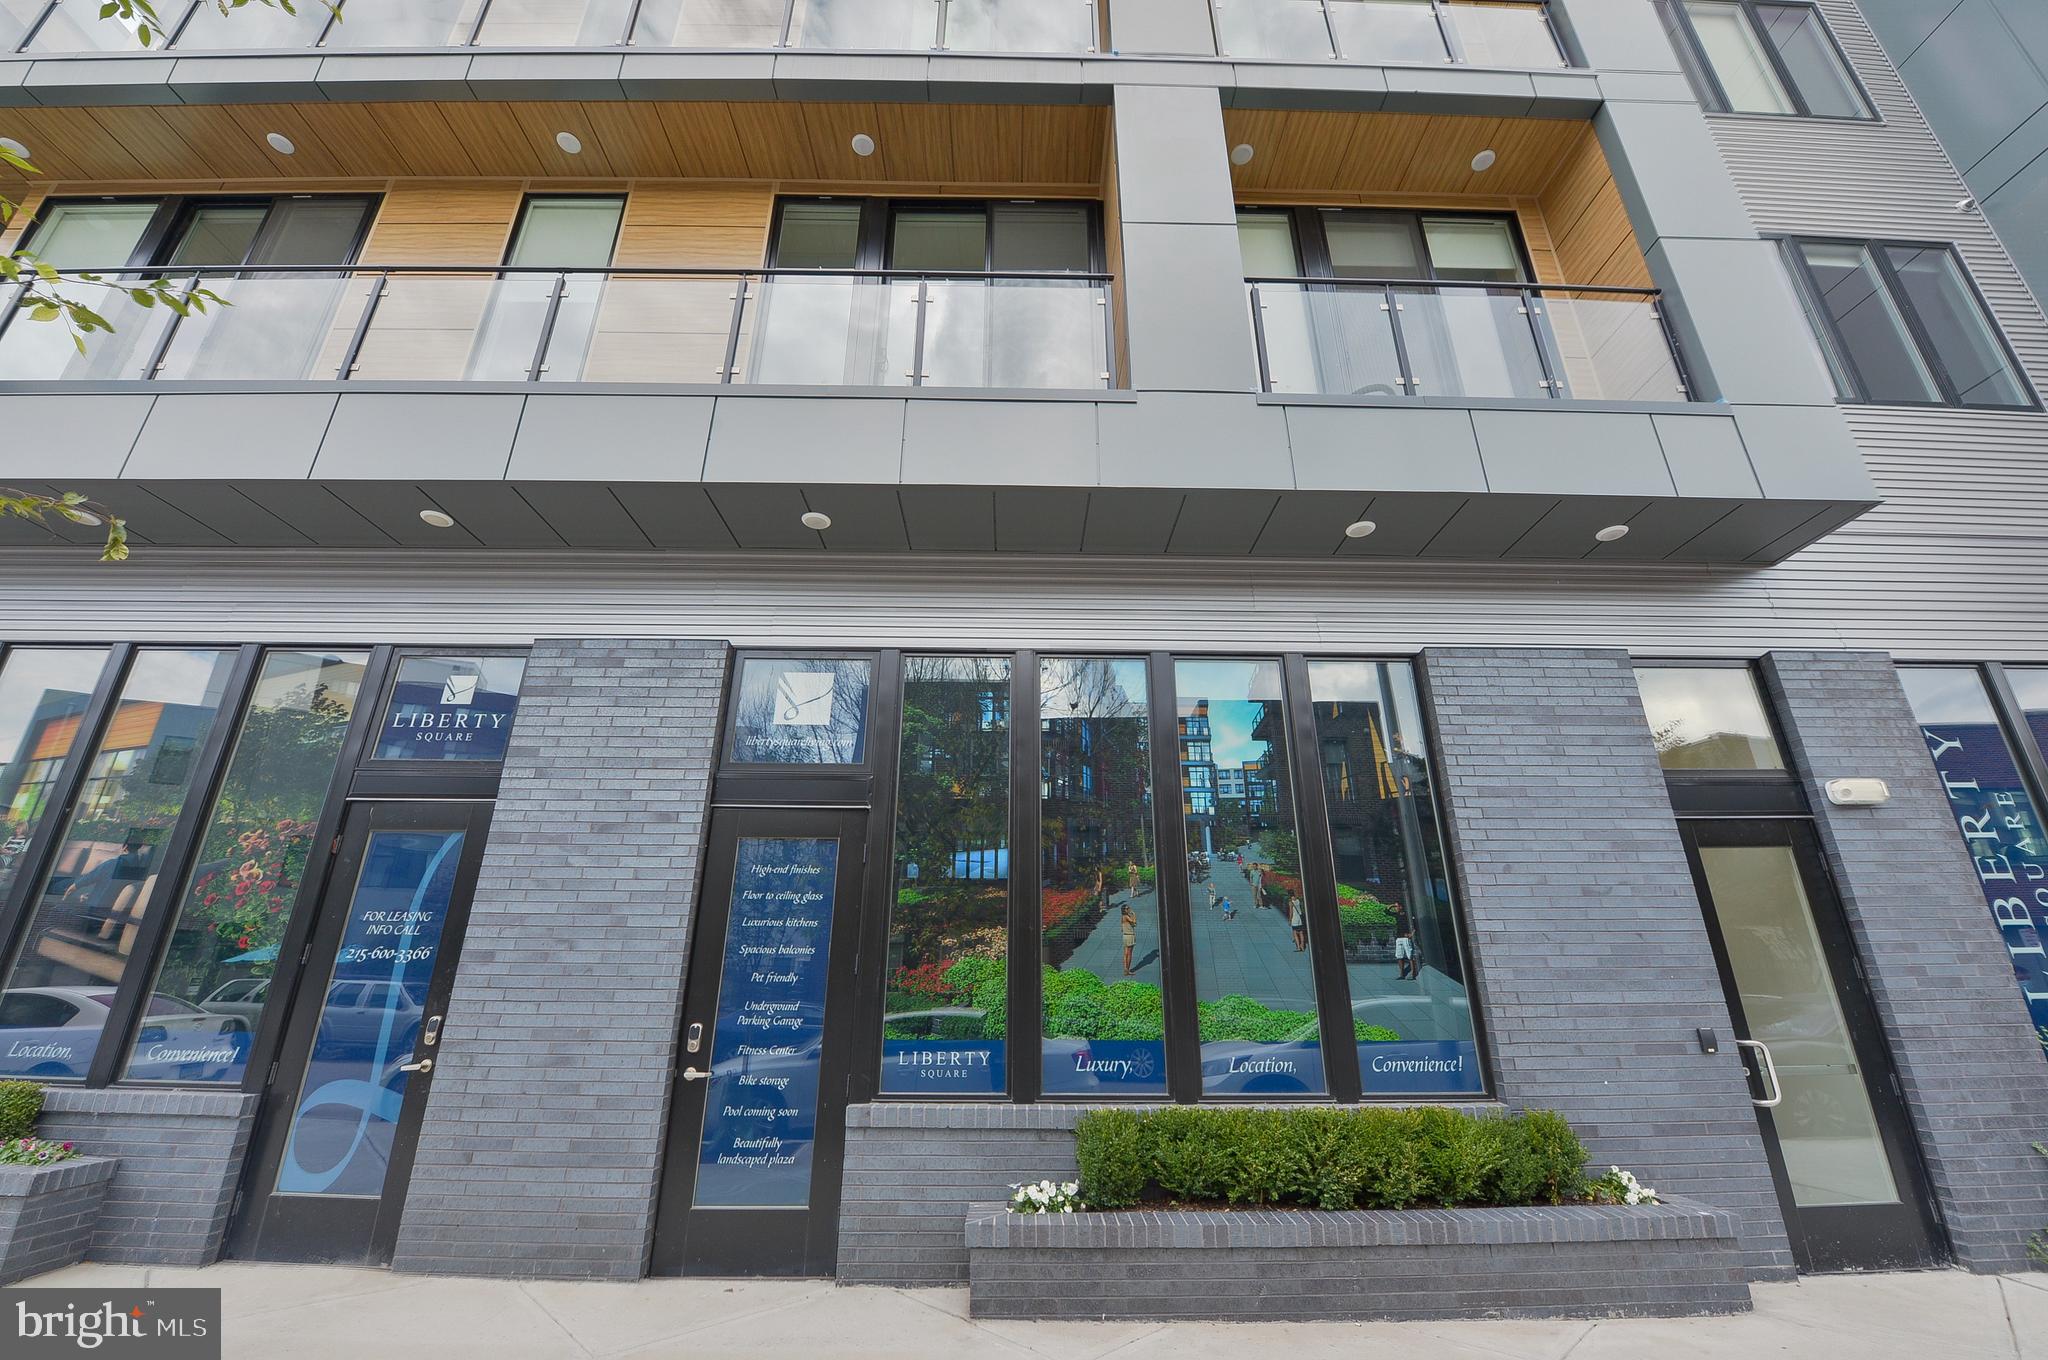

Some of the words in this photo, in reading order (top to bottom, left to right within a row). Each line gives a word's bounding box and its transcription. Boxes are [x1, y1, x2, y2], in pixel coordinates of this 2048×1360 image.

[392, 712, 506, 729] LIBERTY
[415, 732, 474, 742] SQUARE
[1994, 792, 2048, 926] QUARE
[751, 864, 789, 877] High-end
[789, 864, 821, 875] finishes
[742, 890, 764, 900] Floor
[765, 891, 774, 900] to
[775, 891, 801, 904] ceiling
[802, 891, 824, 904] glass
[363, 911, 385, 921] FOR
[387, 911, 433, 922] LEASING
[742, 917, 783, 927] Luxurious
[785, 917, 819, 928] kitchens
[366, 925, 393, 935] INFO
[394, 925, 421, 935] CALL
[346, 946, 433, 963] 215-600-3366
[739, 944, 776, 957] Spacious
[778, 945, 816, 955] balconies
[751, 973, 764, 983] Pet
[765, 971, 799, 986] friendly
[744, 1001, 800, 1015] Underground
[737, 1015, 771, 1030] Parking
[772, 1016, 804, 1030] Garage
[7, 1040, 73, 1059] Location,
[148, 1044, 240, 1063] Convenience!
[737, 1045, 767, 1055] Fitness
[769, 1045, 797, 1055] Center
[899, 1051, 992, 1066] LIBERTY
[1229, 1056, 1297, 1075] Location,
[1372, 1055, 1463, 1072] Convenience!
[920, 1069, 968, 1079] SQUARE
[1075, 1055, 1133, 1080] Luxury,
[739, 1075, 757, 1086] Bike
[760, 1077, 789, 1090] storage
[723, 1106, 743, 1117] Pool
[744, 1107, 776, 1122] coming
[777, 1109, 798, 1117] soon
[733, 1137, 783, 1152] Beautifully
[717, 1153, 768, 1168] landscaped
[768, 1154, 796, 1168] plaza
